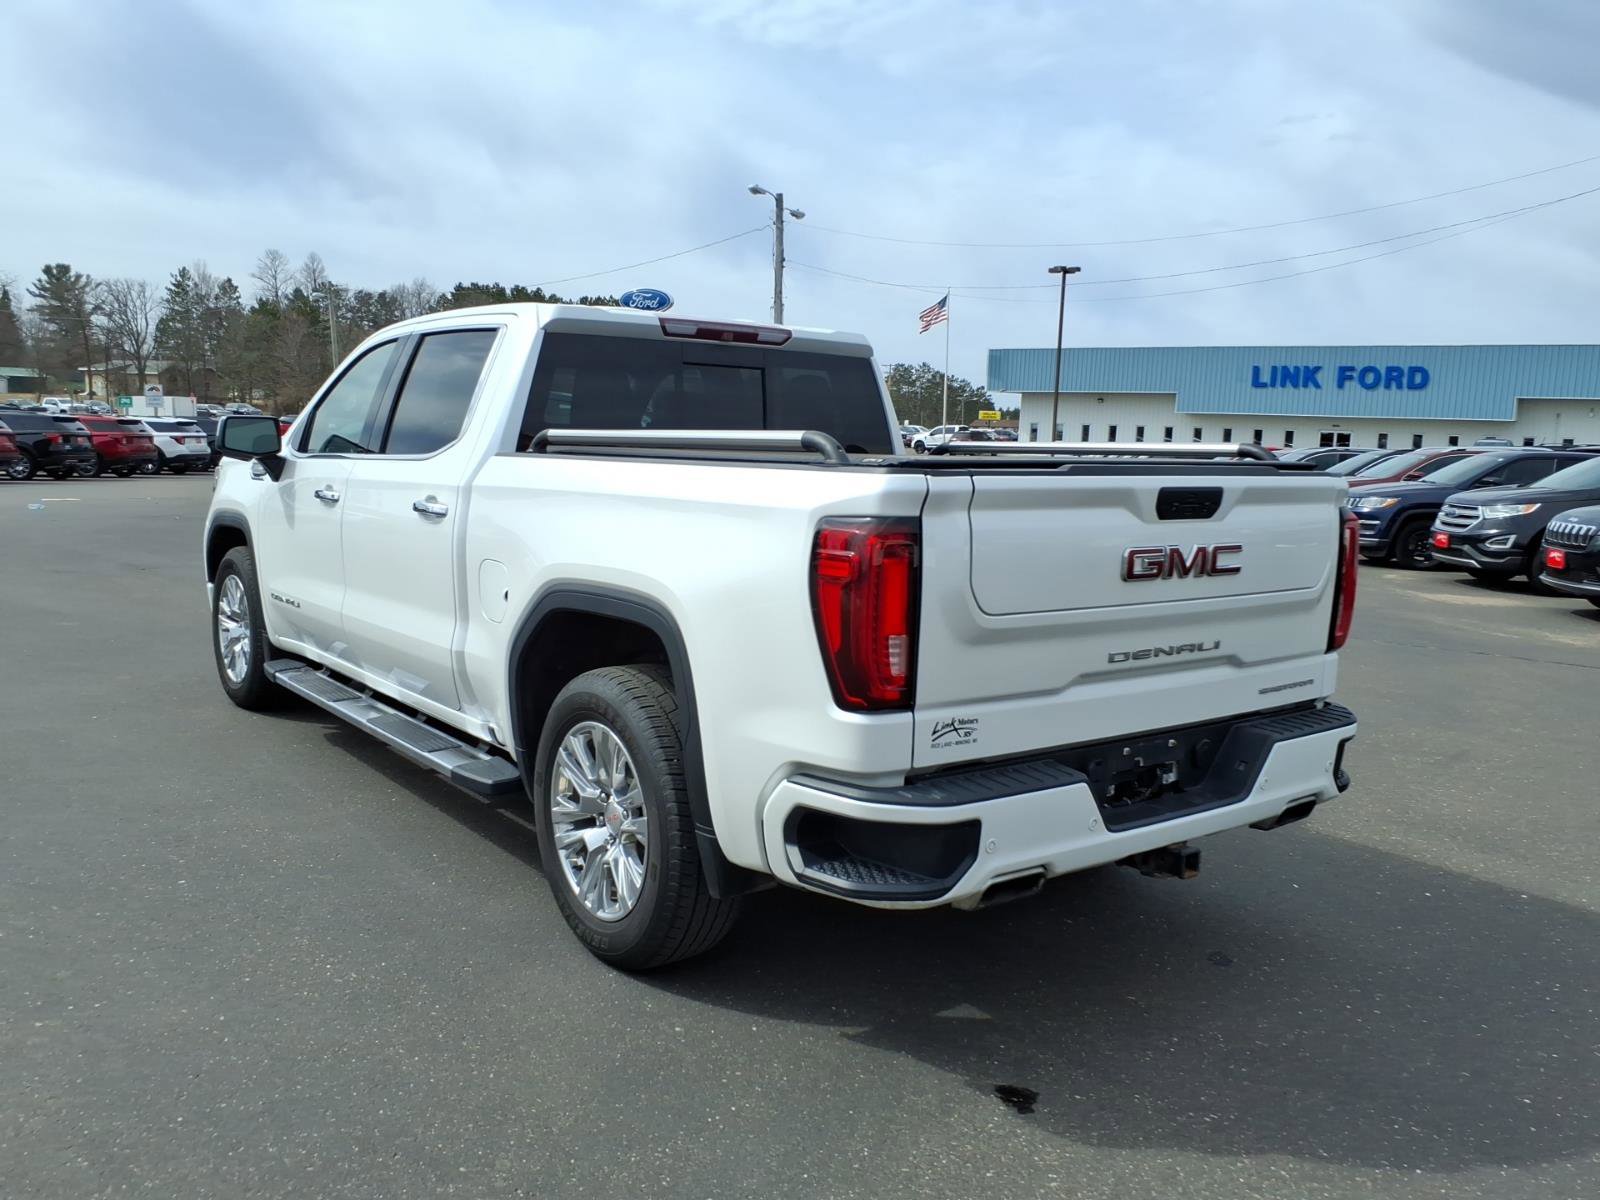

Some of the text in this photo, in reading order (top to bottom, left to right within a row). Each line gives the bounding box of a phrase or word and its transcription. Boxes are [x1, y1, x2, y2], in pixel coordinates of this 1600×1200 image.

[630, 292, 659, 308] Ford
[1251, 365, 1430, 390] LINK FORD
[1121, 543, 1243, 582] GMC
[1108, 640, 1220, 664] DENALI
[931, 717, 962, 738] Link
